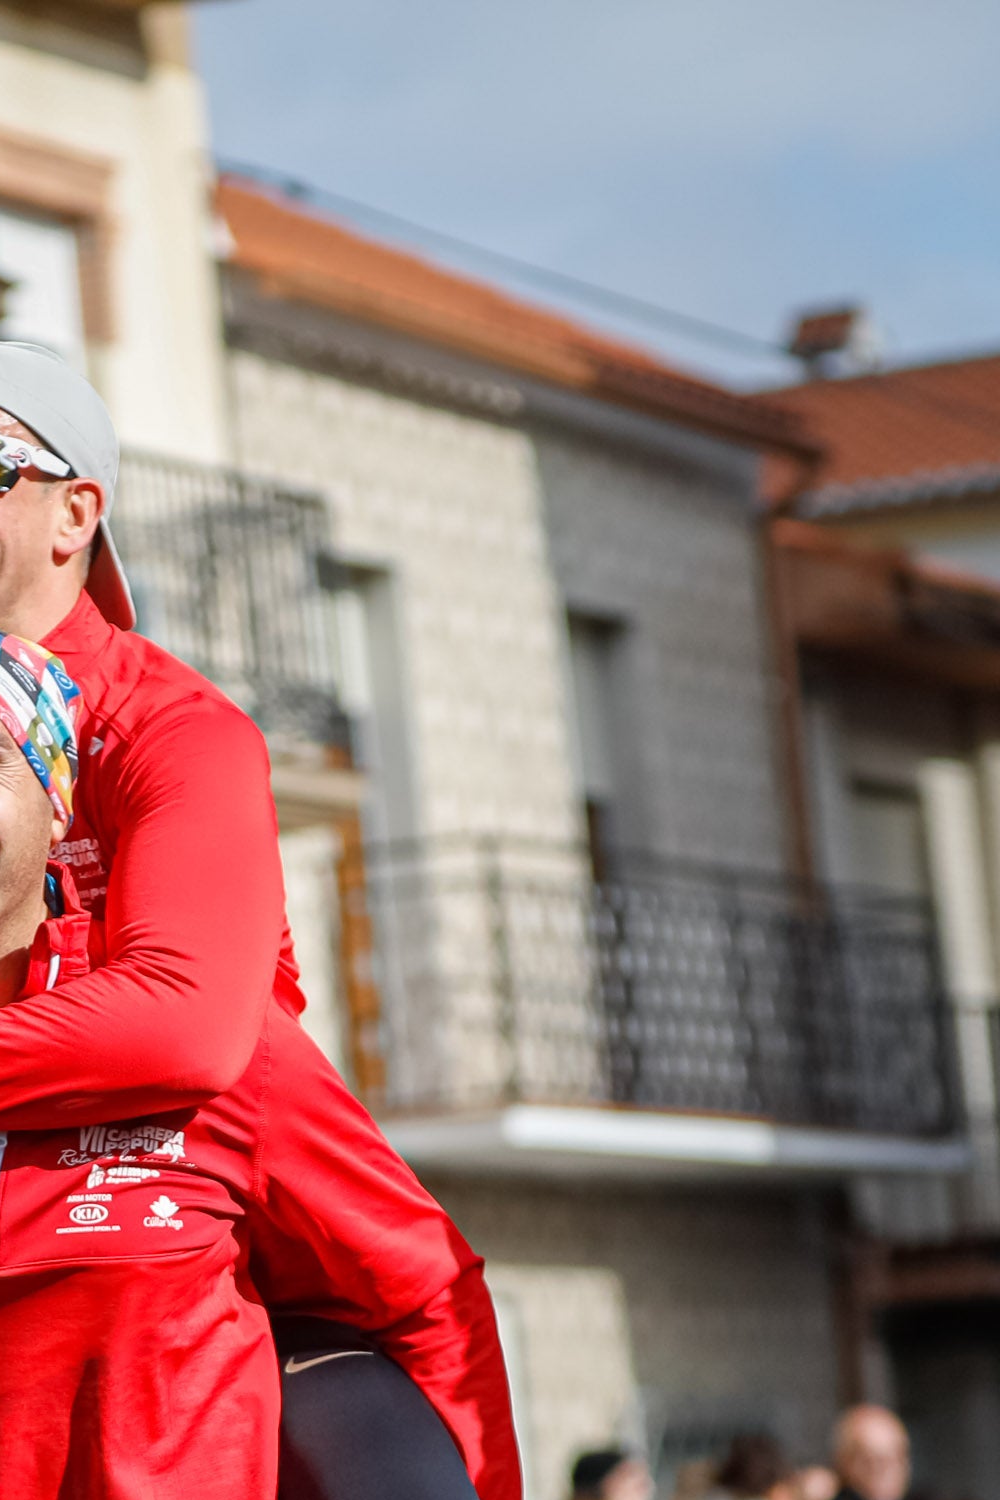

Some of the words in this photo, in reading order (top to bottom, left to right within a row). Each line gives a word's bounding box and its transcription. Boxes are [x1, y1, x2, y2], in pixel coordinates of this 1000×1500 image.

[79, 1127, 106, 1152] VII
[107, 1126, 185, 1145] CARRERA
[105, 1137, 186, 1160] POPULAR
[76, 1207, 102, 1220] KIA
